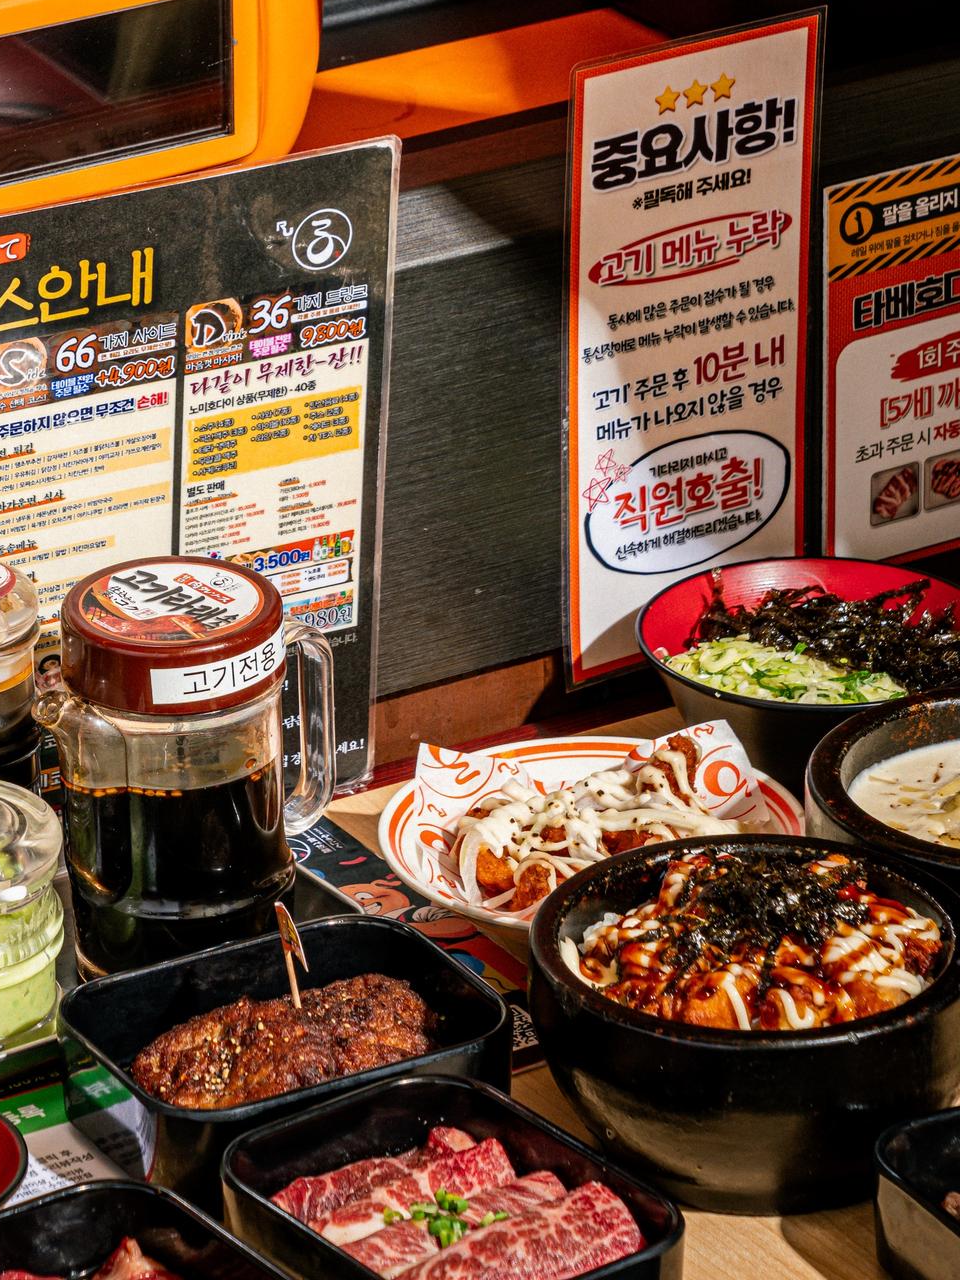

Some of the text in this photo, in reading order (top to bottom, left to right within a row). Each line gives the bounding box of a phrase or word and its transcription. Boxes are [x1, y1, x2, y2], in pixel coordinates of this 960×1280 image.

[591, 97, 797, 190] 중요사항!
[696, 168, 752, 196] 주세요!
[882, 188, 958, 227] 팔을 올리지
[598, 209, 785, 286] 고기 메뉴 누락
[248, 294, 292, 335] 36
[325, 284, 369, 306] 드링크
[607, 294, 703, 332] 동시에 주문이
[55, 333, 98, 373] 66
[132, 322, 178, 343] 사이드
[300, 317, 367, 349] 9,800원
[663, 324, 697, 345] 누락이
[95, 356, 176, 387] +4,900원
[190, 366, 251, 397] 다같이
[634, 334, 786, 399] 주문 후 10분 내
[95, 397, 135, 418] 무조건
[136, 390, 169, 411] 손해!
[189, 394, 235, 416] 노미호다이
[596, 375, 783, 443] 메뉴가 나오지 않을 경우
[855, 433, 914, 463] 초과 주문
[648, 454, 694, 480] 기다리지
[613, 456, 764, 536] 직원호출!
[614, 536, 661, 562] 신속하게
[183, 641, 277, 696] 고기전용
